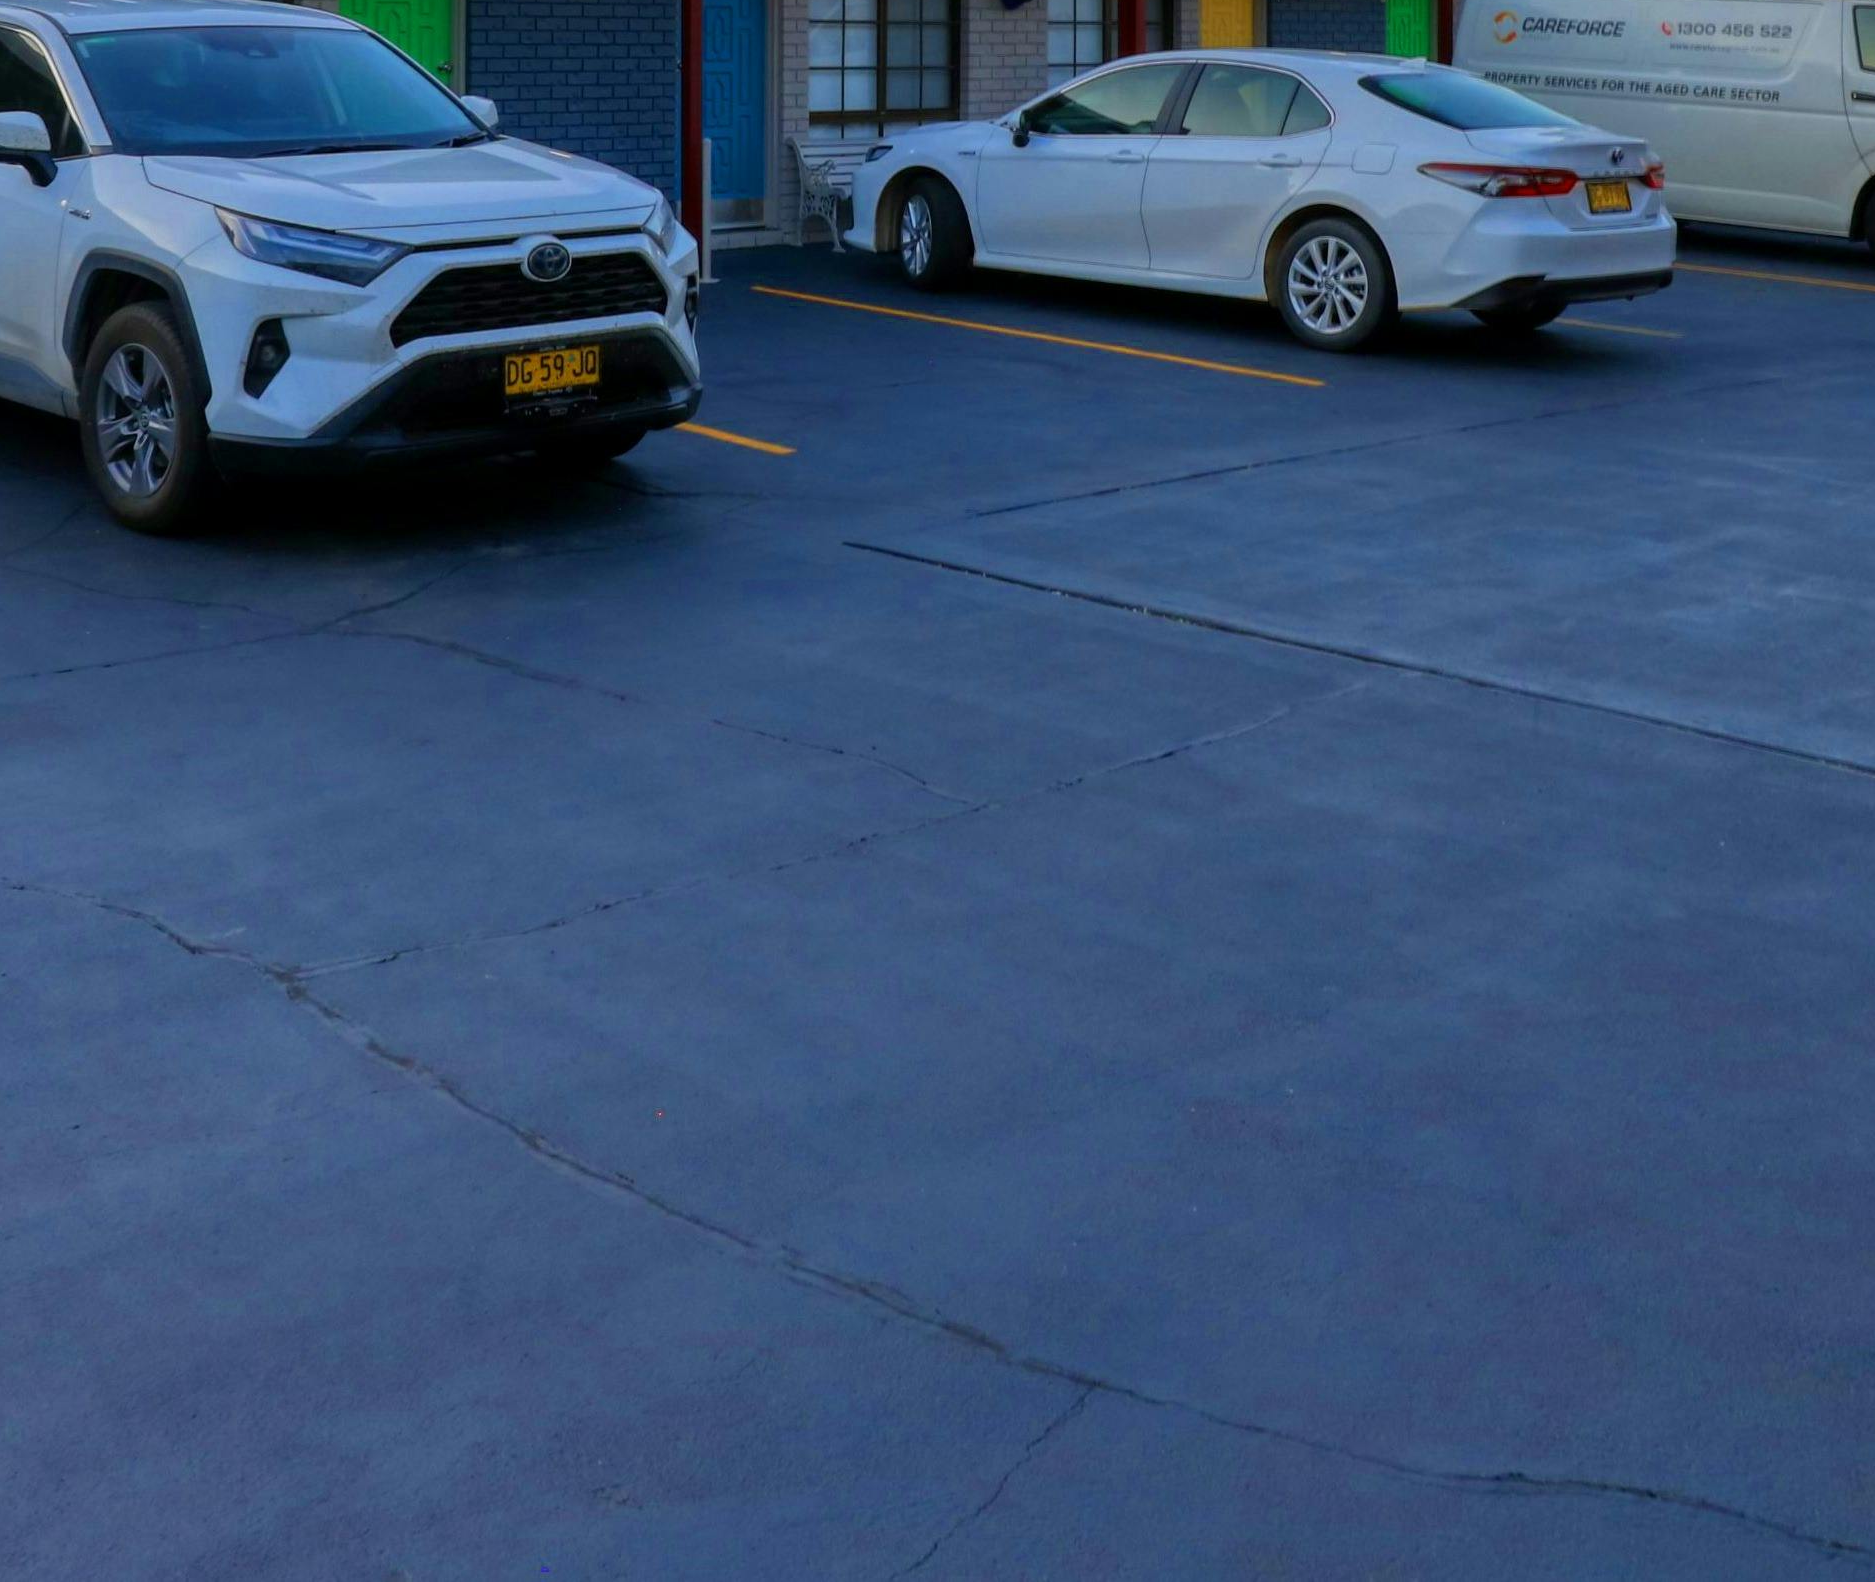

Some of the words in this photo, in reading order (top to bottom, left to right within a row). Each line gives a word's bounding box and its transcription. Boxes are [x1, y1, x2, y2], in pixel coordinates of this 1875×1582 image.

[1522, 16, 1626, 38] CAREFORCE
[1677, 21, 1717, 36] 1300
[1759, 24, 1793, 39] 522
[1484, 70, 1541, 87] PROPERTY
[1544, 75, 1598, 91] SERVICES
[1601, 78, 1625, 92] FOR
[1629, 80, 1651, 94] THE
[1654, 82, 1689, 97] AGED
[1693, 84, 1726, 99] CARE
[1730, 87, 1781, 103] SECTOR
[507, 358, 534, 387] DG
[540, 353, 565, 382] 59
